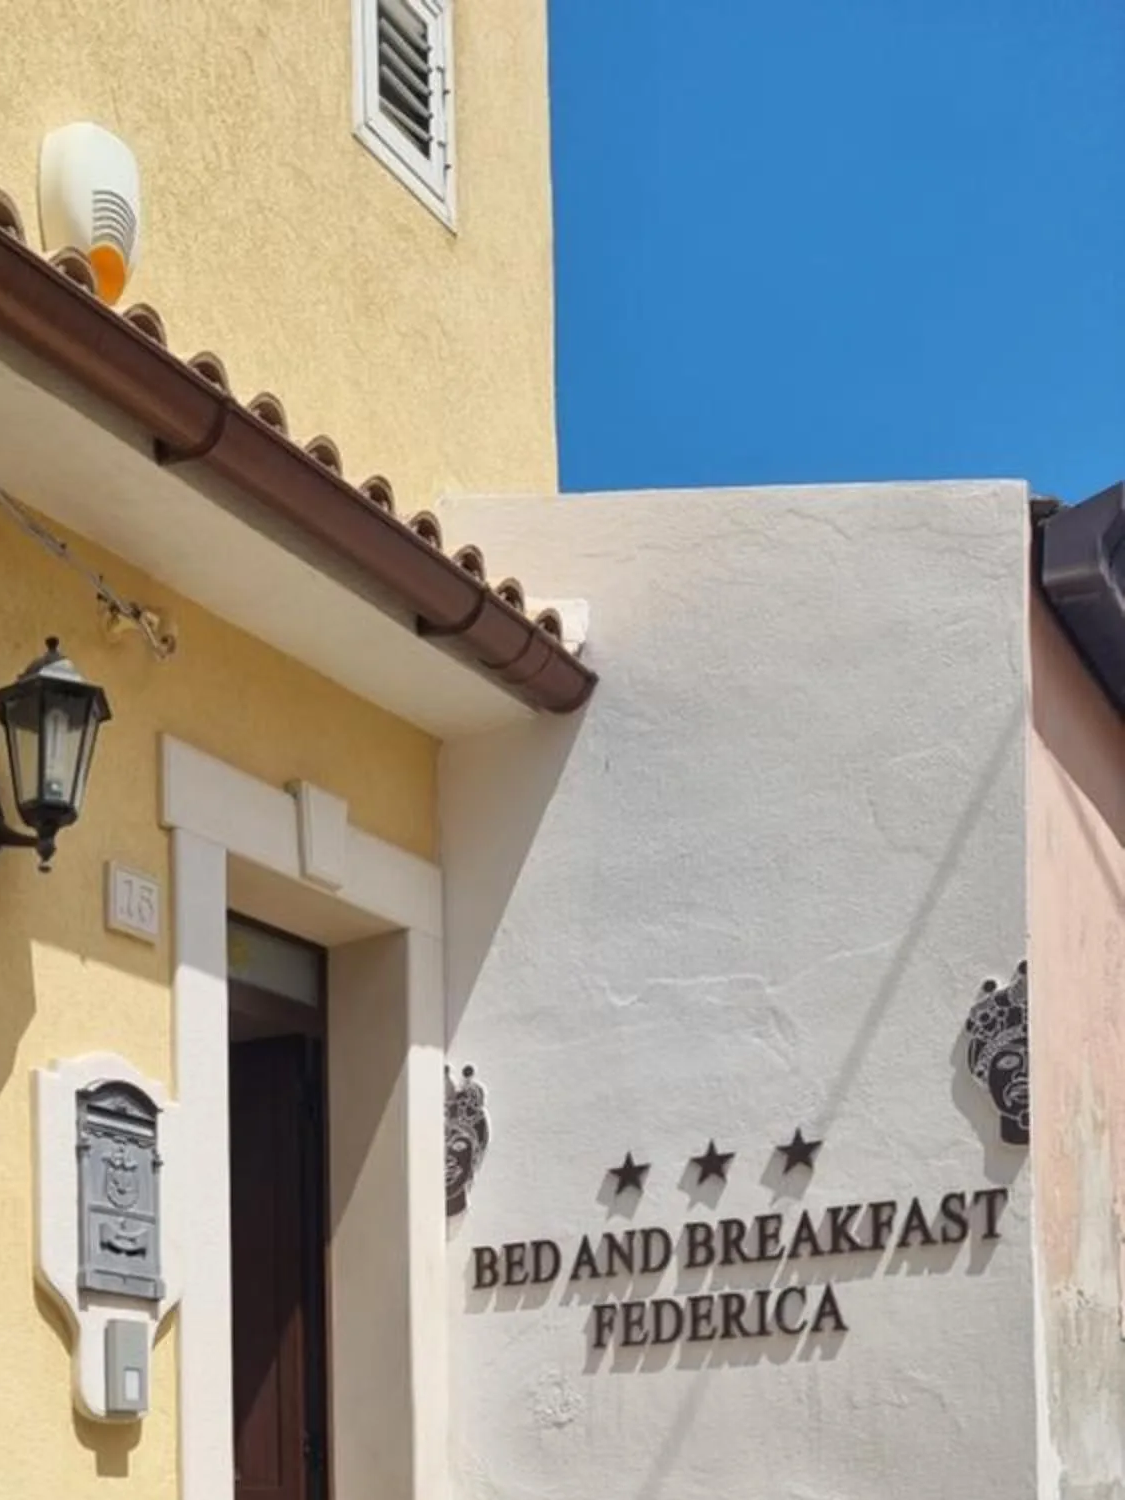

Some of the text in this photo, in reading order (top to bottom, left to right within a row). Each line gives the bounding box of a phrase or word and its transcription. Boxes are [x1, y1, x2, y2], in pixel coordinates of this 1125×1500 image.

[472, 1187, 1008, 1290] BED AND BREAKFAST
[592, 1281, 849, 1348] FEDERICA
